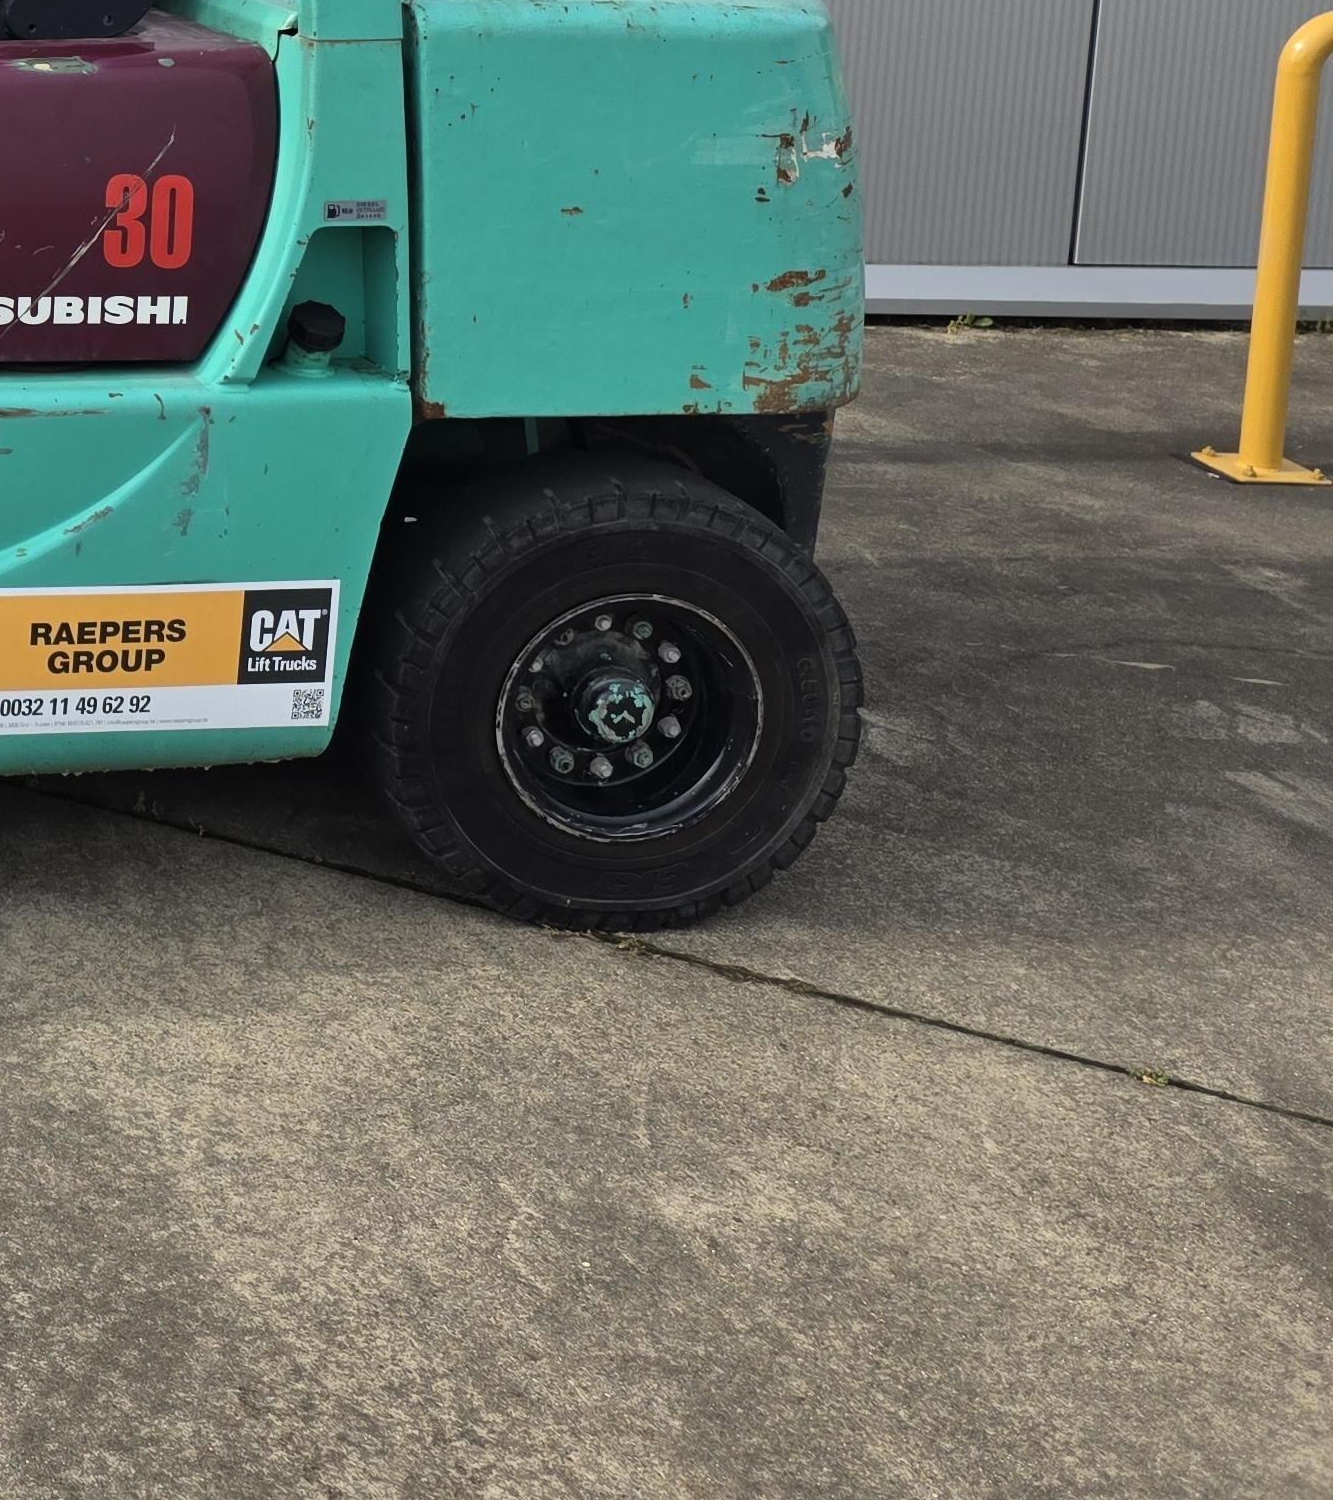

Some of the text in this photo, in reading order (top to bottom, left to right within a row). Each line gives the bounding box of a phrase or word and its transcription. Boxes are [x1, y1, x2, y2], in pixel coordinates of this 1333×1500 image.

[103, 173, 194, 269] 30
[30, 618, 187, 646] RAEPERS
[47, 648, 166, 675] GROUP
[247, 655, 317, 672] Lift Trucks
[0, 698, 44, 717] 0032
[49, 697, 69, 716] 11
[75, 696, 98, 715] 49
[102, 695, 125, 715] 62
[128, 694, 151, 714] 92
